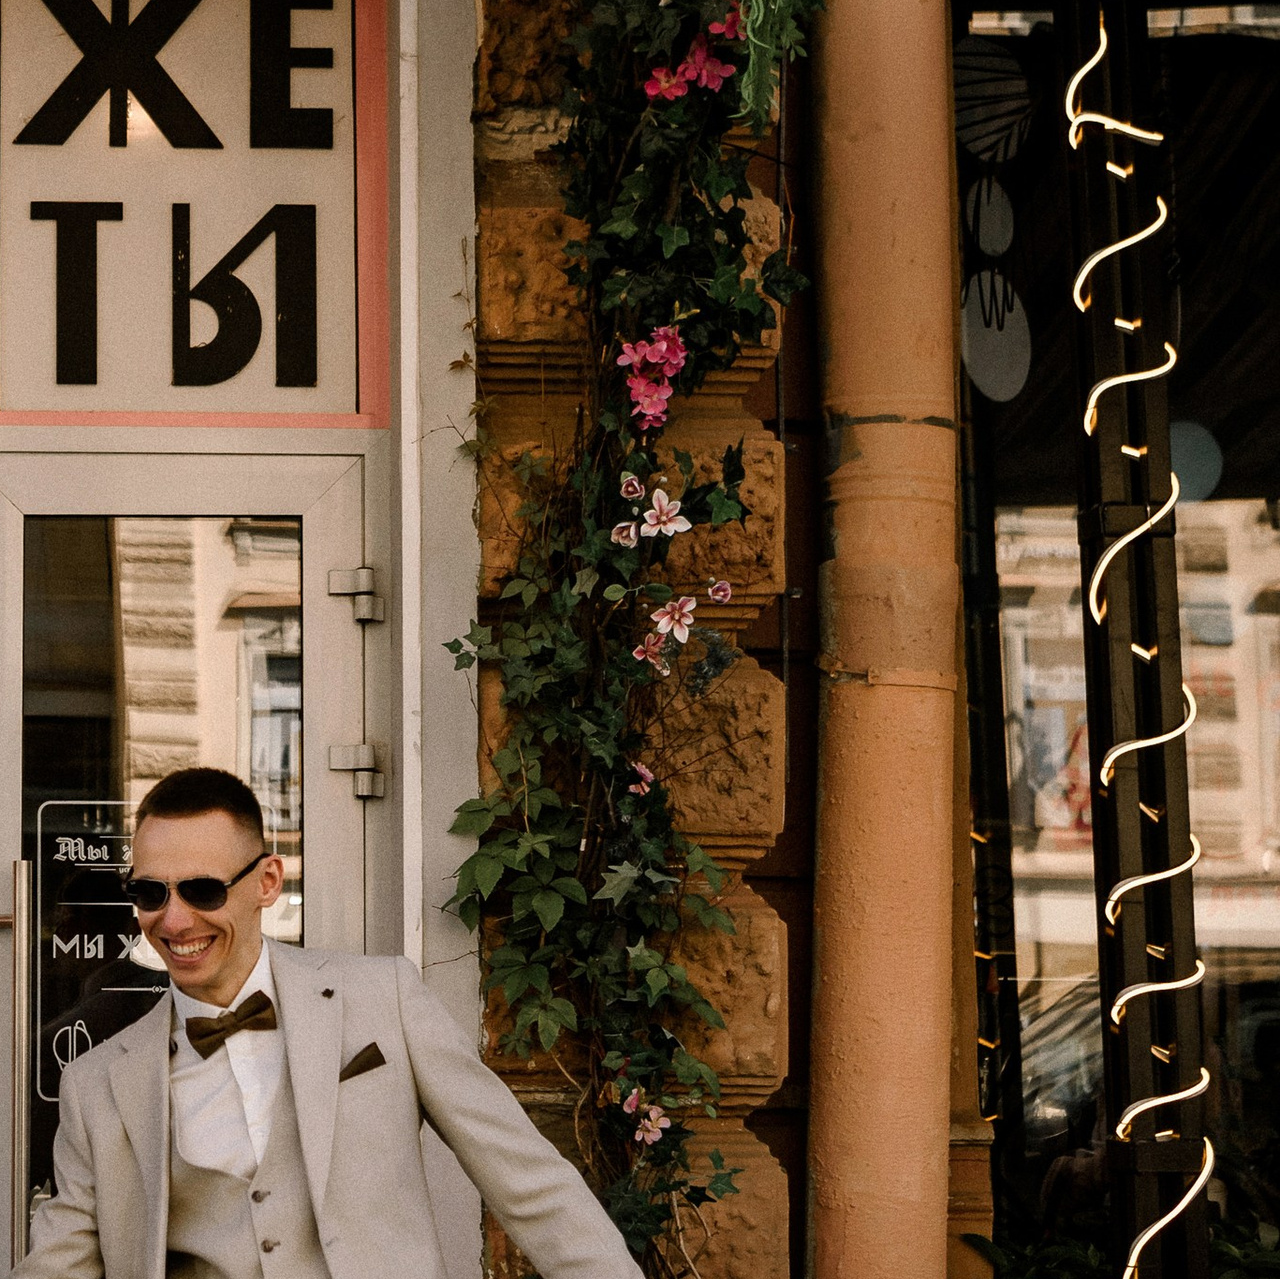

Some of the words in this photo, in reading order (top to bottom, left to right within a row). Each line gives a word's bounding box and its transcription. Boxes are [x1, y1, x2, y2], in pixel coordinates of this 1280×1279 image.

[30, 201, 318, 388] ТЫ
[53, 836, 110, 862] Мы
[52, 933, 105, 960] МЫ
